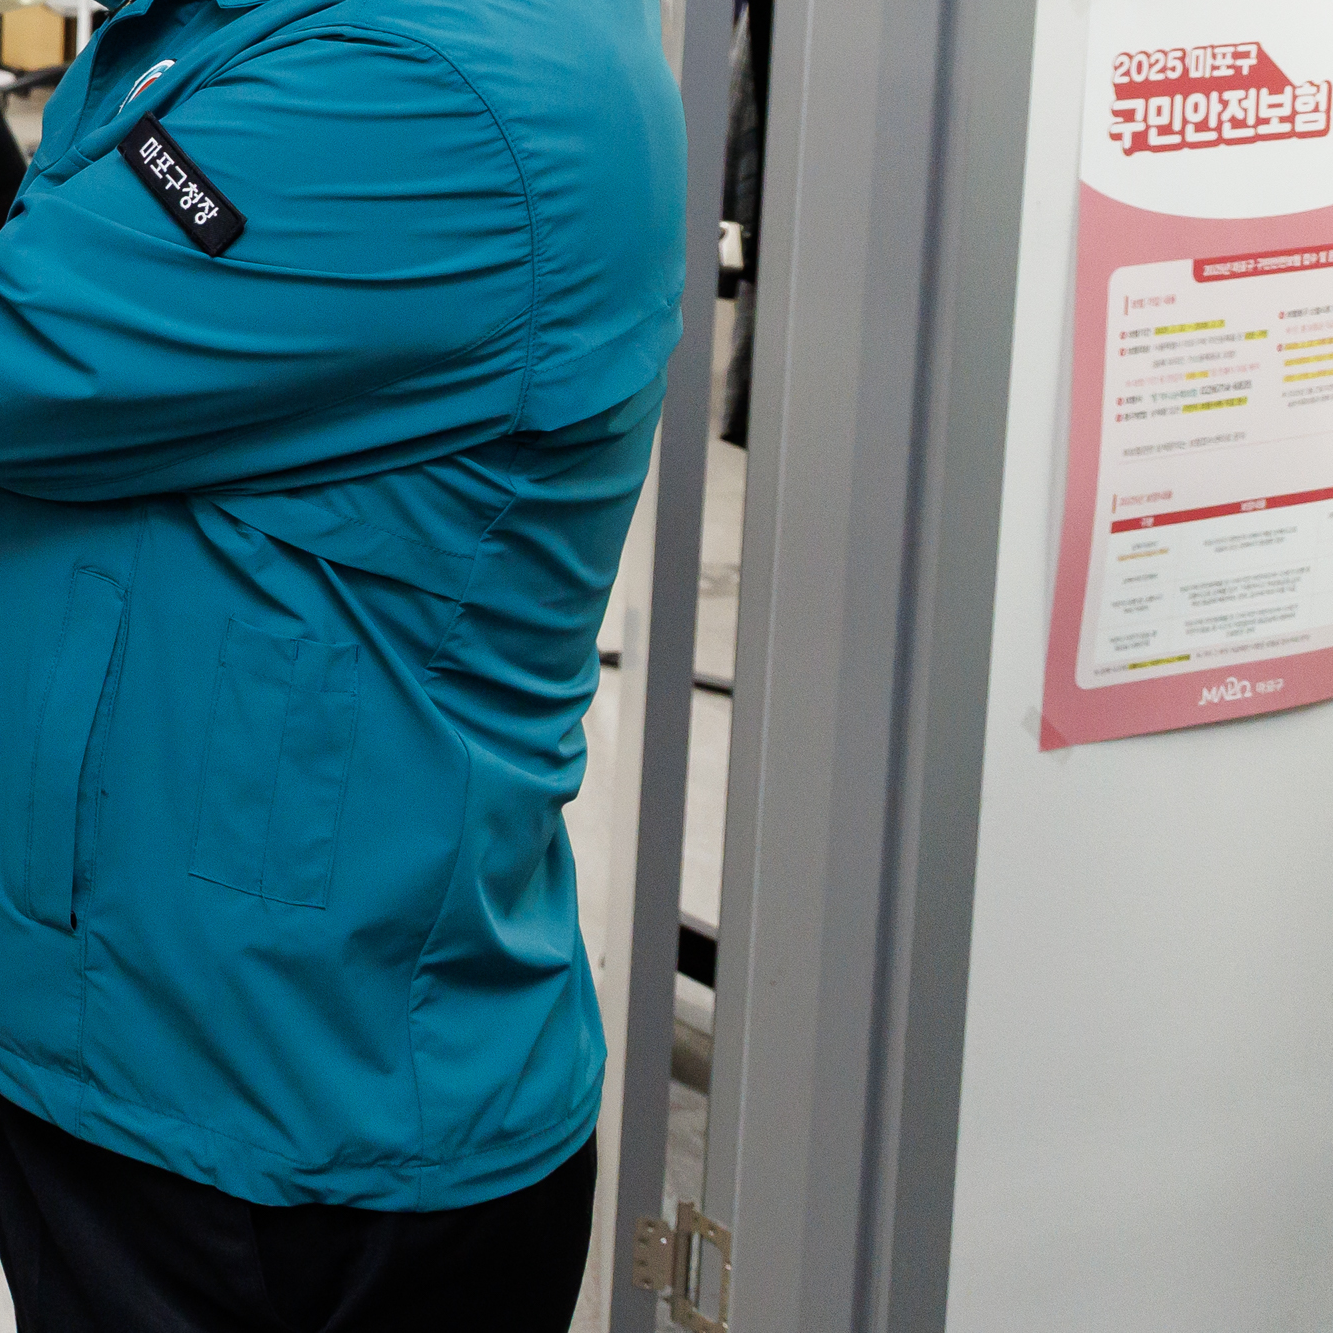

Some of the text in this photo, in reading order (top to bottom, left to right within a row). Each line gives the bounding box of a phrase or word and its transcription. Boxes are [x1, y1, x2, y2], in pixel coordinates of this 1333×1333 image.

[1113, 43, 1259, 85] 2025 마포구
[1108, 79, 1330, 151] 구민안전보험
[138, 135, 221, 226] 마포구청장
